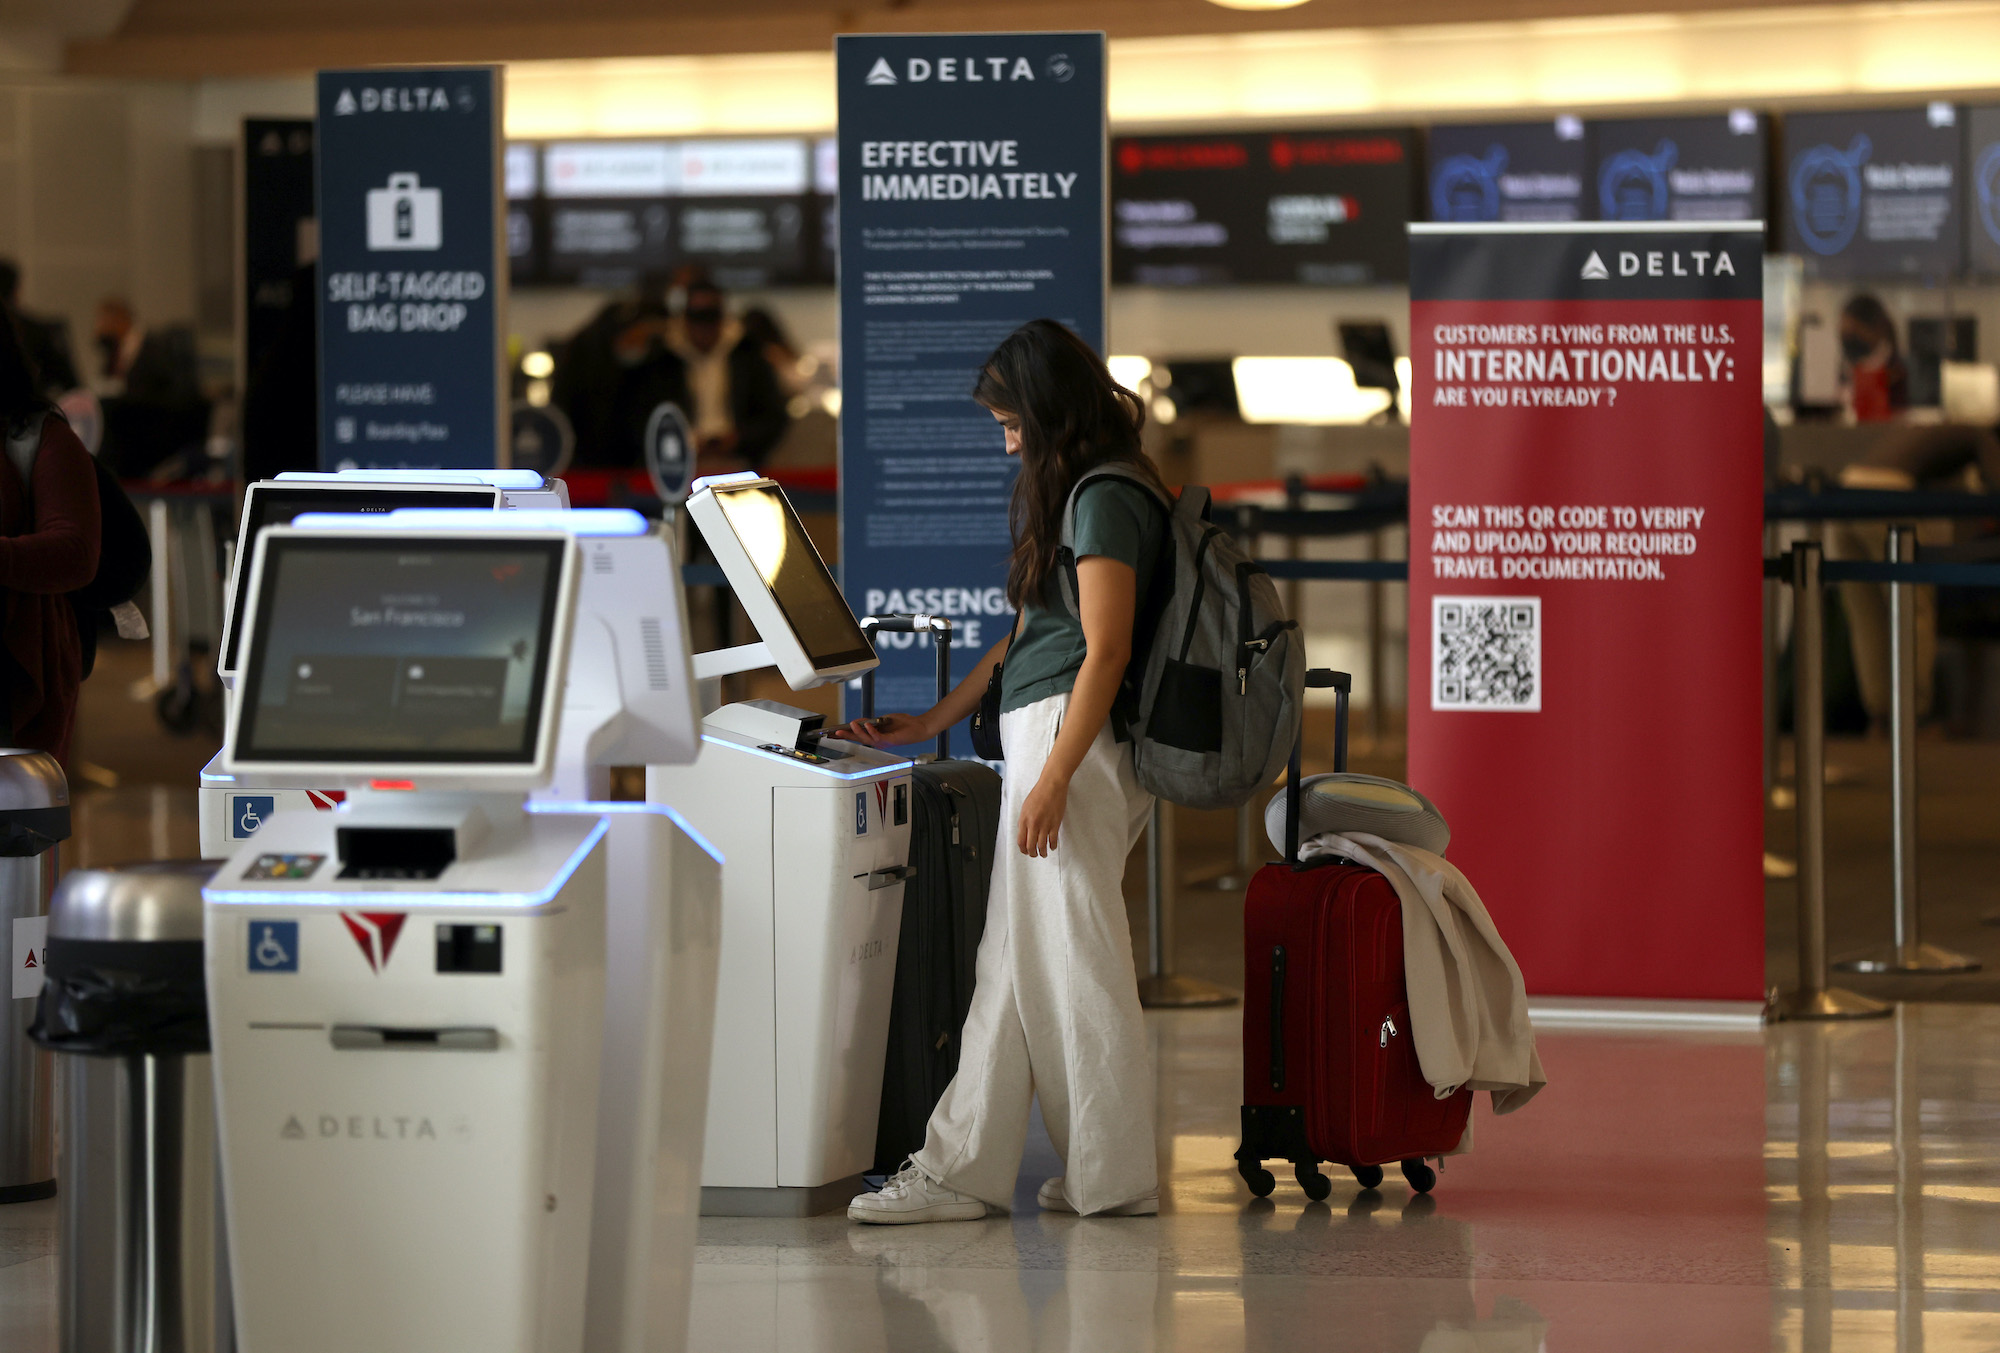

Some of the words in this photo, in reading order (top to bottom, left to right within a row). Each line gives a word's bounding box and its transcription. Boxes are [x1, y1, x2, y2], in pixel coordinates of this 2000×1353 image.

[907, 57, 1035, 82] DELTA
[361, 87, 449, 112] DELTA
[861, 140, 1018, 168] EFFECTIVE
[861, 172, 1078, 201] IMMEDIATELY
[1619, 250, 1736, 277] DELTA
[329, 271, 485, 301] SELF-TAGGED
[347, 304, 398, 333] BAG
[401, 303, 468, 331] DROP
[1433, 324, 1538, 345] CUSTOMERS
[1541, 324, 1604, 344] FLYING
[1607, 324, 1658, 344] FROM
[1662, 324, 1697, 344] THE
[1700, 324, 1735, 344] U.S.
[1434, 349, 1735, 382] INTERNATIONALLY:
[1433, 386, 1468, 407] ARE
[1470, 386, 1508, 407] YOU
[1432, 504, 1480, 528] SCAN
[1482, 505, 1525, 528] THIS
[1527, 505, 1555, 531] QR
[1558, 506, 1608, 529] CODE
[1611, 506, 1637, 529] TO
[1640, 507, 1705, 529] VERIFY
[1431, 530, 1471, 553] AND
[1474, 531, 1547, 554] UPLOAD
[1550, 532, 1602, 554] YOUR
[1605, 532, 1697, 556] REQUIRED
[1431, 555, 1499, 579] TRAVEL
[1501, 557, 1665, 581] DOCUMENTATION.
[350, 607, 381, 627] San
[385, 608, 465, 628] Francisco
[876, 620, 982, 649] NOCE
[858, 940, 882, 961] DELTA
[318, 1116, 437, 1140] DELTA
